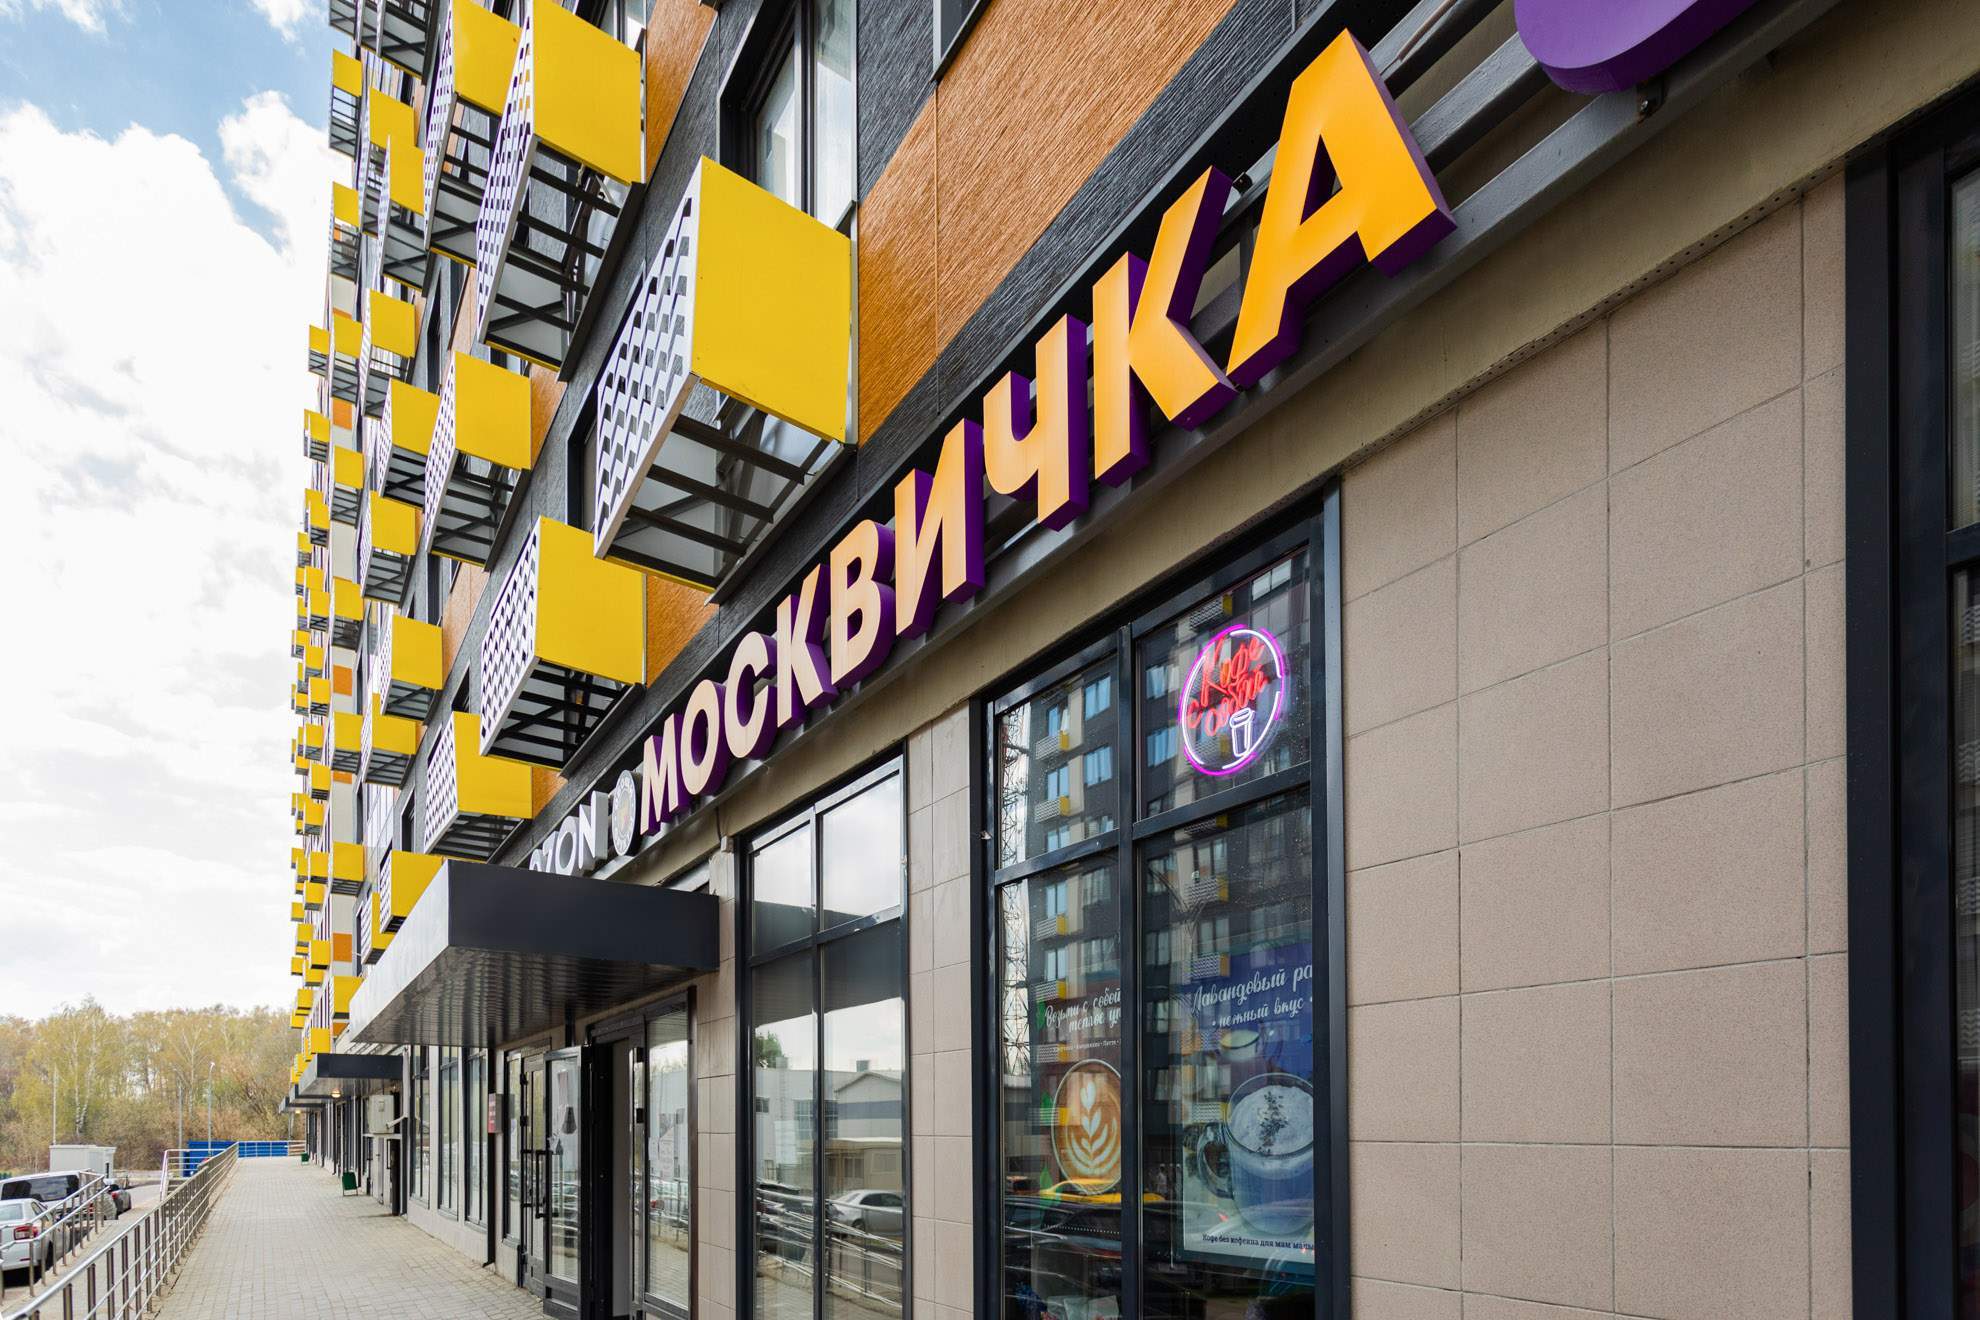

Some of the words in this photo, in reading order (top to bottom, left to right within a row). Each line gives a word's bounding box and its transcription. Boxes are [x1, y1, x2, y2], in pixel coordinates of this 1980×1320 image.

[641, 28, 1446, 836] МОСКВИЧКА
[1201, 636, 1265, 707] Кофе
[1093, 987, 1120, 1009] собой
[1193, 968, 1286, 1013] Лавандовый
[1219, 1003, 1269, 1027] нежный
[1273, 997, 1304, 1017] вкус
[1202, 1233, 1217, 1243] Кофе
[1219, 1235, 1229, 1243] без
[1230, 1237, 1259, 1246] кофеина
[1259, 1239, 1274, 1248] для
[1274, 1240, 1292, 1249] мам
